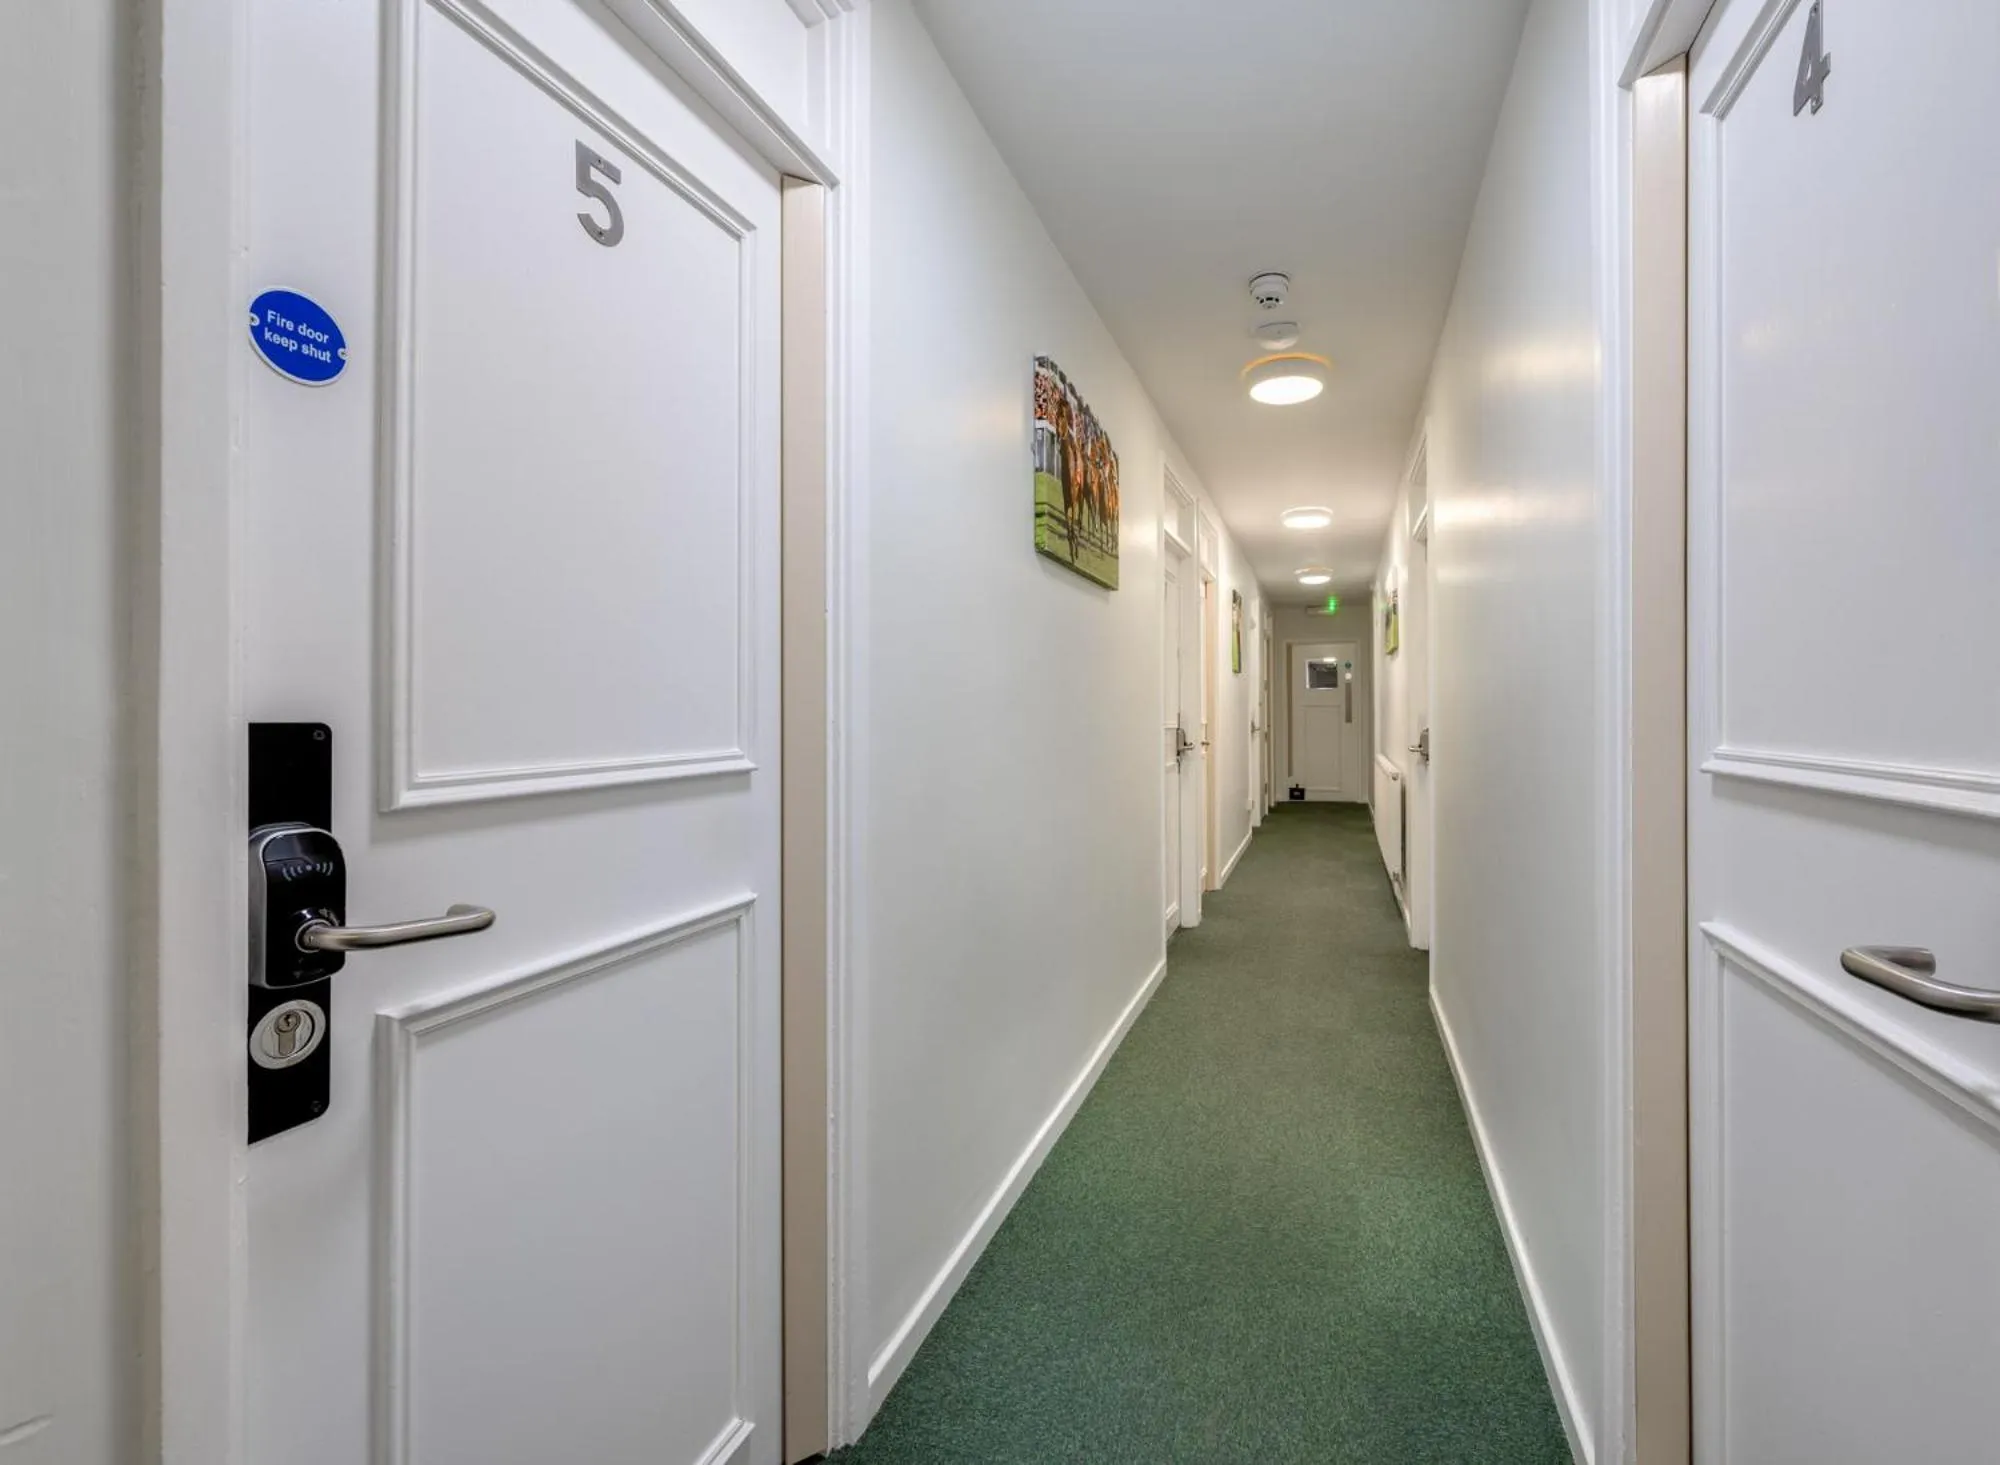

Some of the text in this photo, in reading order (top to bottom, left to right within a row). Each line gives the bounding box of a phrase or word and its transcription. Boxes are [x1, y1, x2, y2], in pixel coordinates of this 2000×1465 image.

[1793, 0, 1831, 117] 4
[575, 138, 624, 248] 5
[264, 327, 331, 363] keep shut
[267, 309, 329, 343] Fire door
